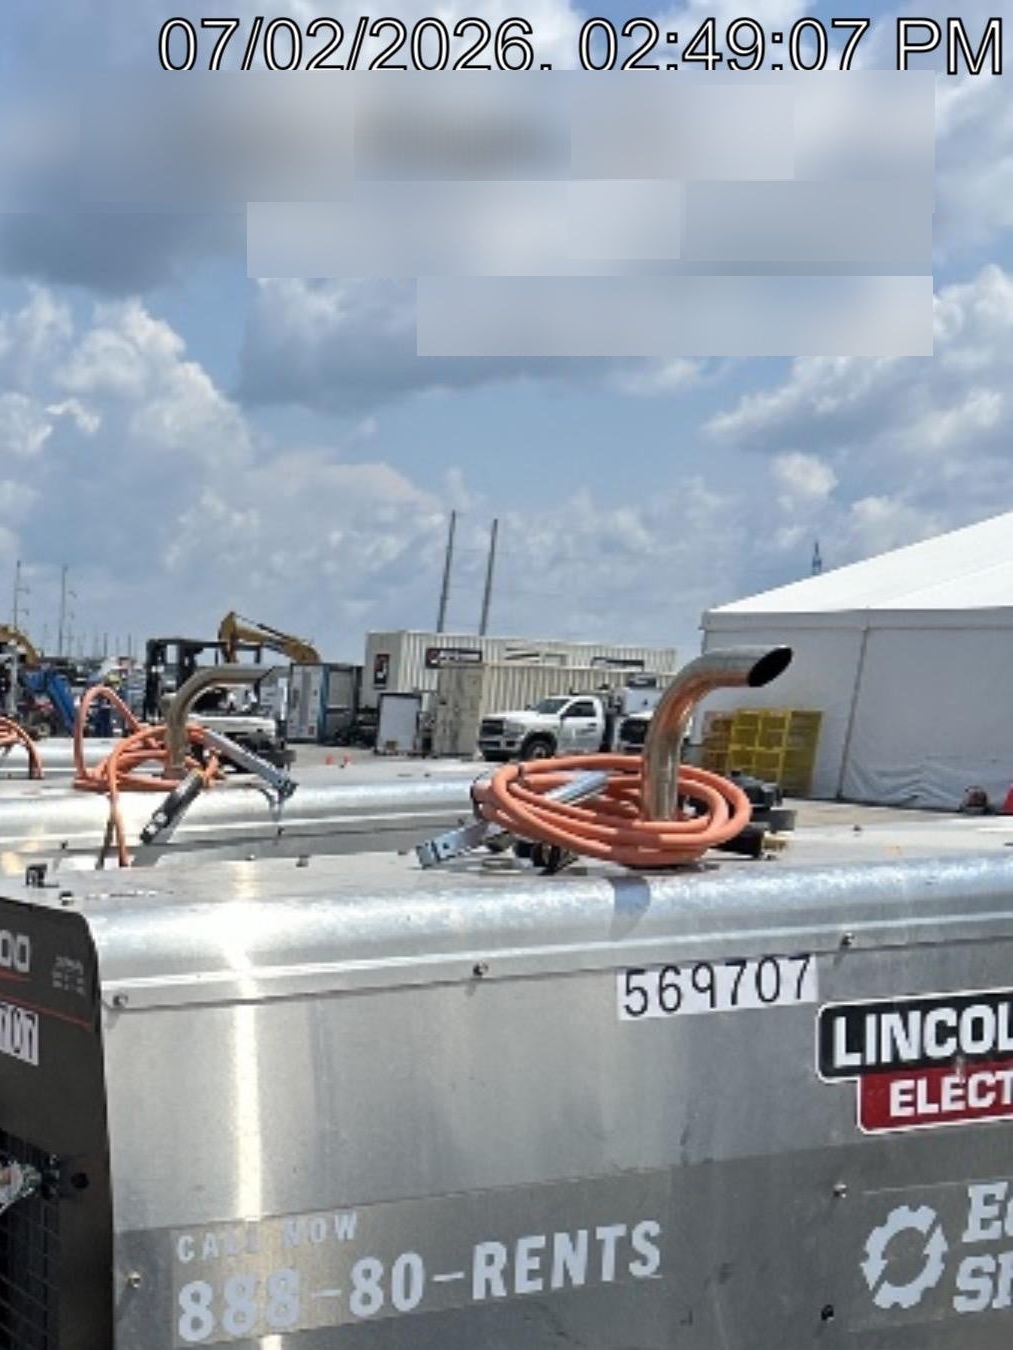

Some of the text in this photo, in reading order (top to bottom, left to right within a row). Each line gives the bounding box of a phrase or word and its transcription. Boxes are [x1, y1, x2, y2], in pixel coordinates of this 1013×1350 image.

[624, 953, 811, 1017] 569707
[178, 1209, 358, 1264] CALL NOW
[962, 1181, 1013, 1243] E
[179, 1220, 660, 1343] 888-80-RENTS
